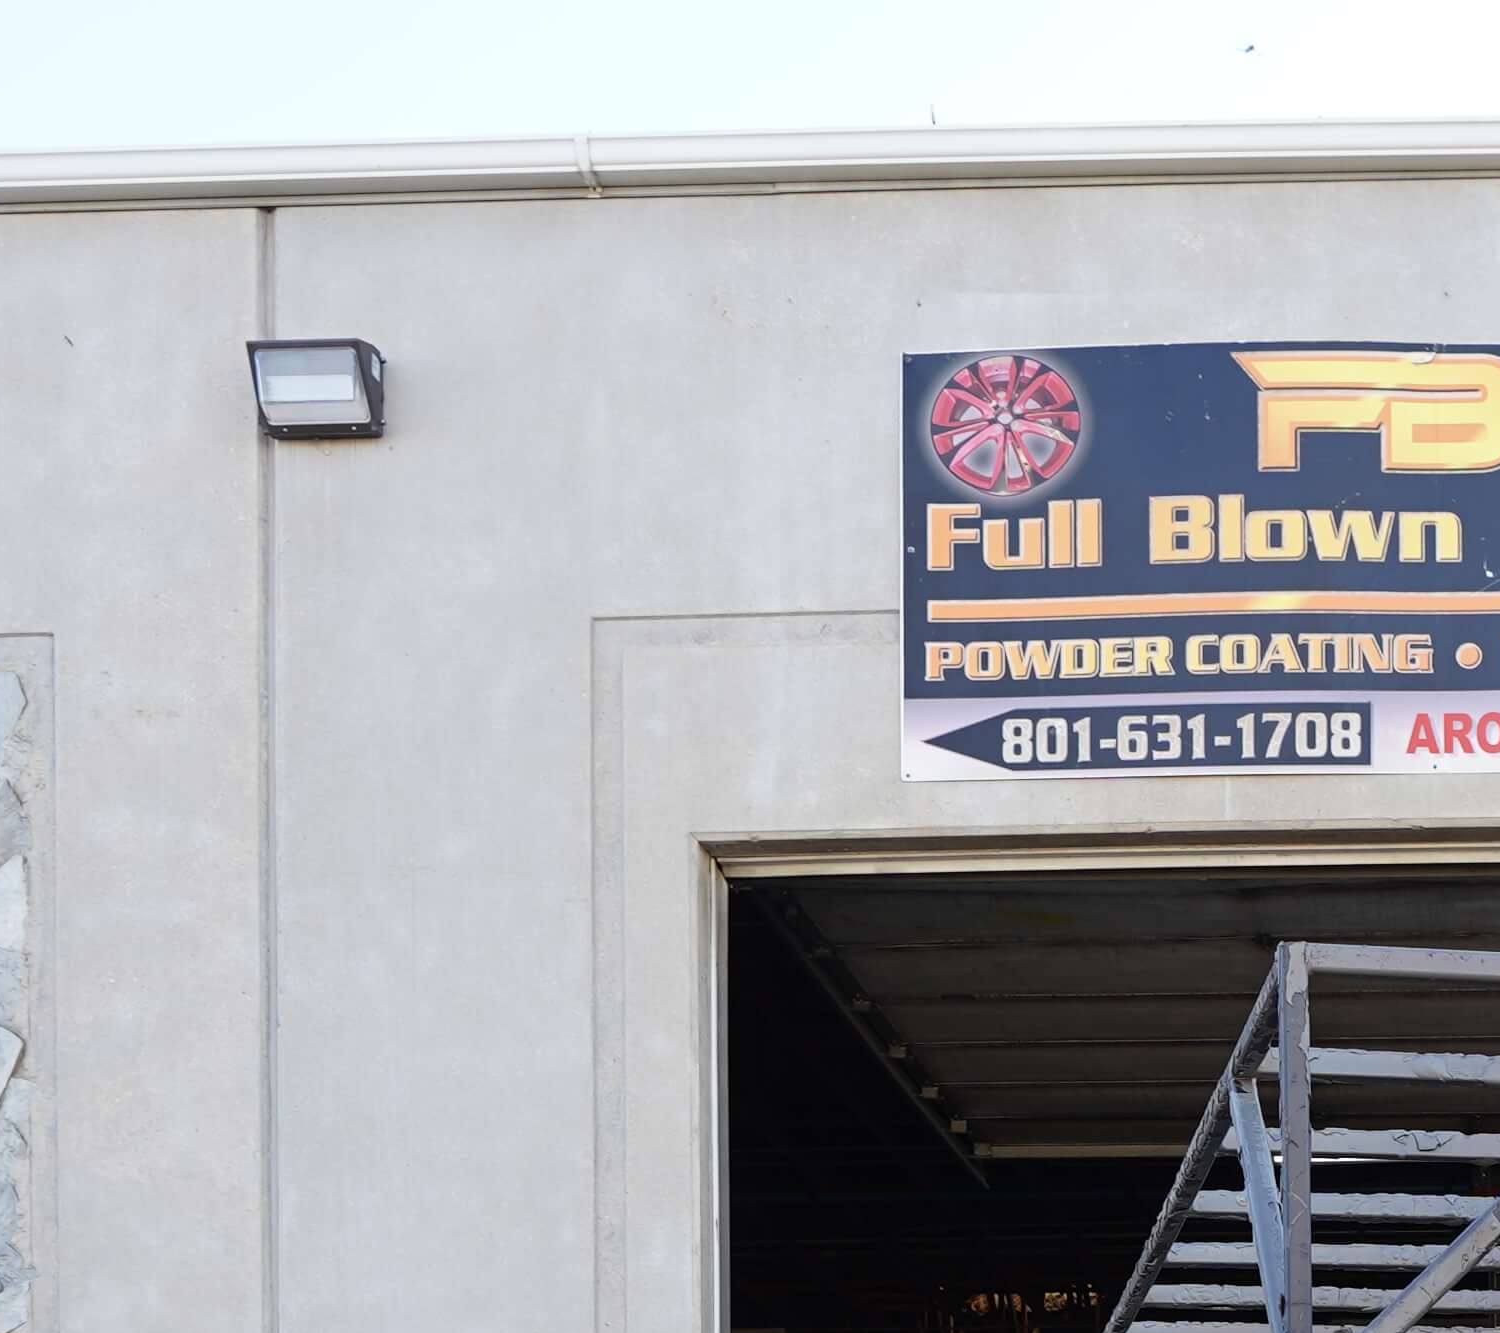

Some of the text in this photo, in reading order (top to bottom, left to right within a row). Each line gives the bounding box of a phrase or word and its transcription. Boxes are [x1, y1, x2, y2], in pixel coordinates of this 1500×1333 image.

[926, 498, 1102, 571] Full
[1148, 494, 1463, 565] Blown
[924, 636, 1175, 681] POWDER
[1185, 633, 1435, 674] COATING
[1002, 711, 1363, 764] 801-631-1708
